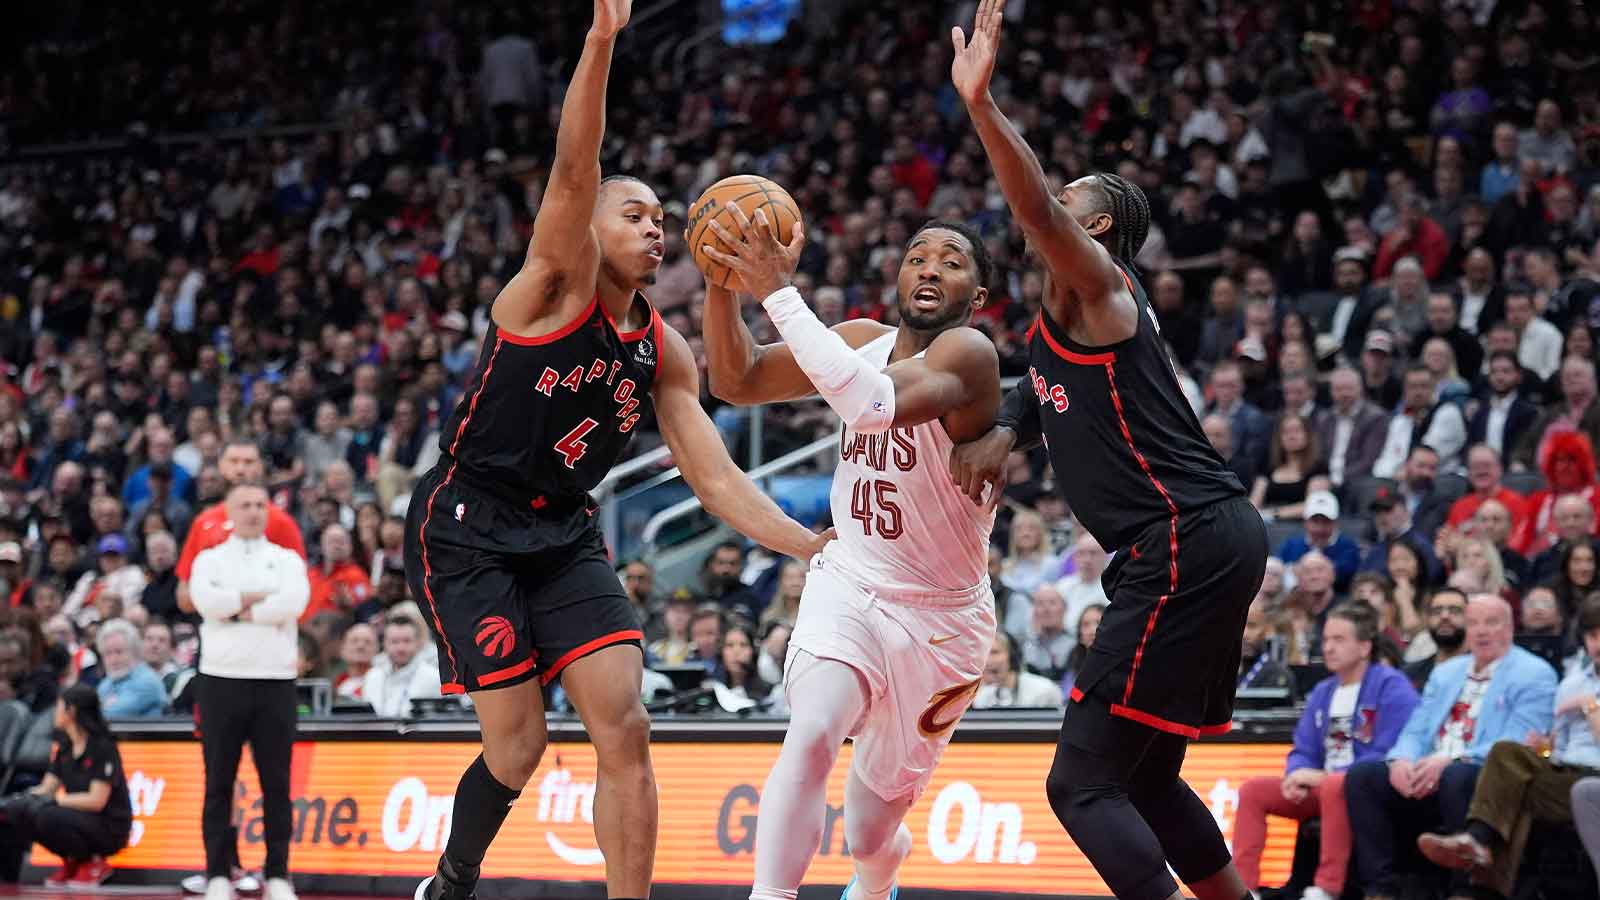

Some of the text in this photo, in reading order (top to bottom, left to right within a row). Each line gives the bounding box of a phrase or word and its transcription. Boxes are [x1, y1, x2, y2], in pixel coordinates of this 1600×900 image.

[644, 357, 656, 366] Life
[535, 358, 641, 432] RAPTORS
[553, 416, 600, 469] 4
[841, 421, 917, 472] CAVS
[851, 477, 904, 540] 45
[237, 783, 368, 846] ame.
[928, 781, 1037, 863] On.
[1209, 780, 1239, 833] t
